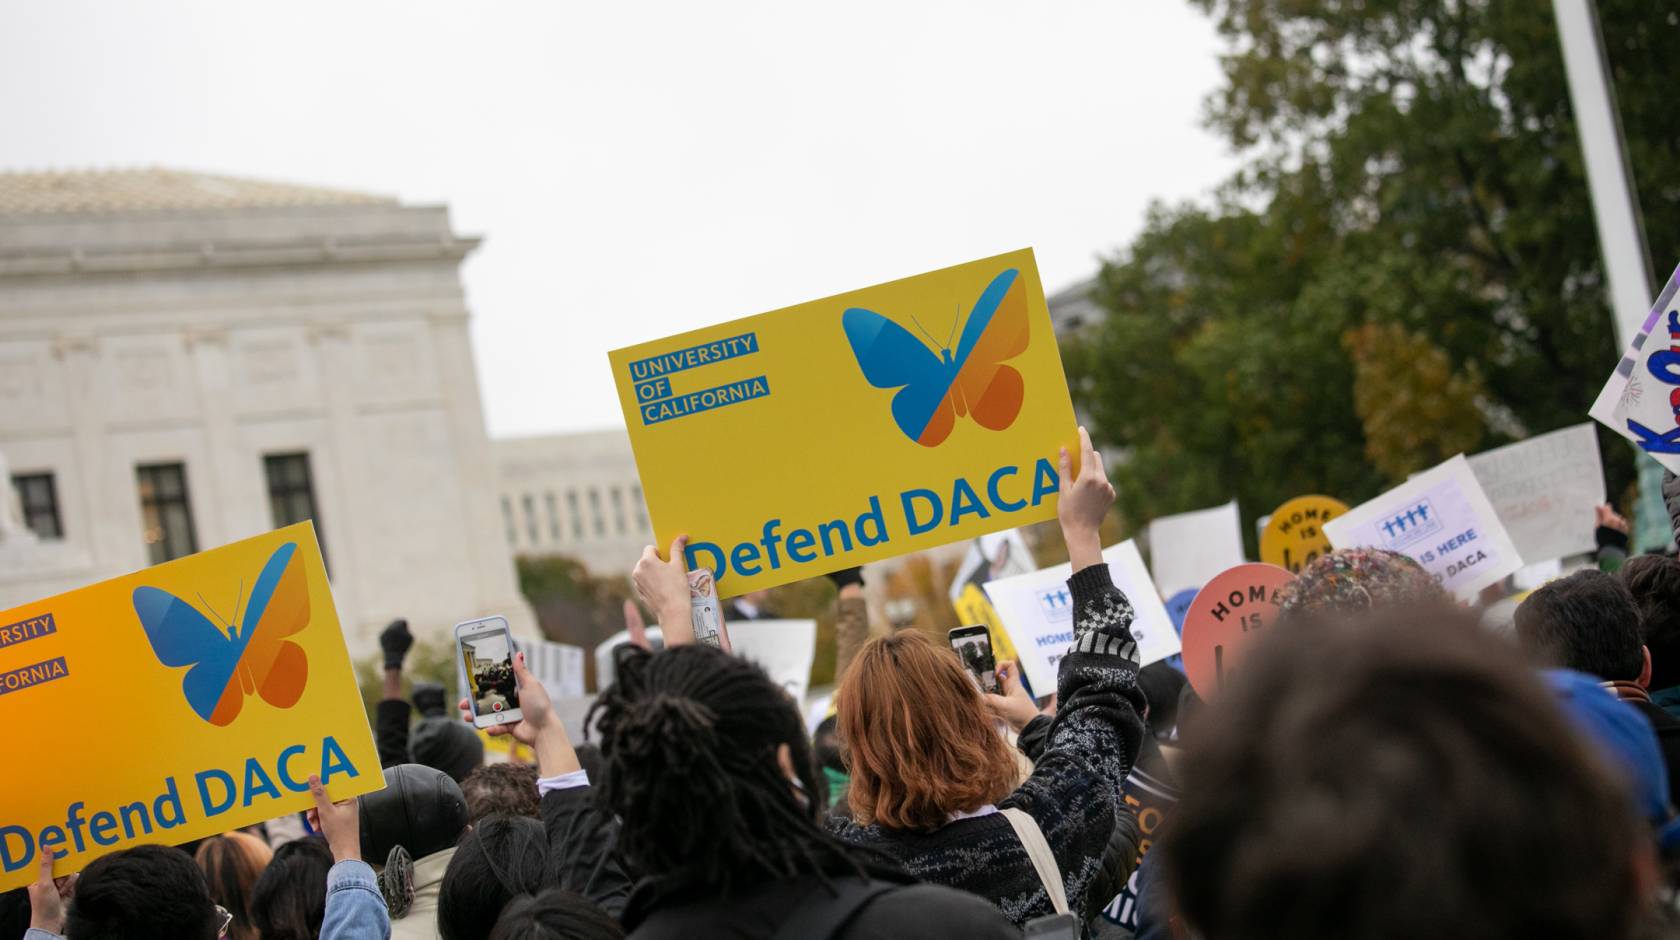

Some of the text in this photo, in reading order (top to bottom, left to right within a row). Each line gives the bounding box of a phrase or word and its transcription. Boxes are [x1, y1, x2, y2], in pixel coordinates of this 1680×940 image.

[634, 335, 753, 379] UNIVERSITY
[640, 381, 665, 400] OF
[645, 380, 766, 422] CALIFORNIA
[684, 458, 1060, 582] Defend DACA
[1279, 508, 1331, 534] HOME
[1300, 526, 1316, 540] IS
[1419, 550, 1436, 565] IS
[1436, 528, 1478, 556] HERE
[1446, 550, 1487, 577] DACA
[1211, 584, 1281, 622] HOME
[1240, 612, 1262, 633] IS
[1035, 631, 1073, 648] HOME
[1, 735, 360, 873] Defend DACA
